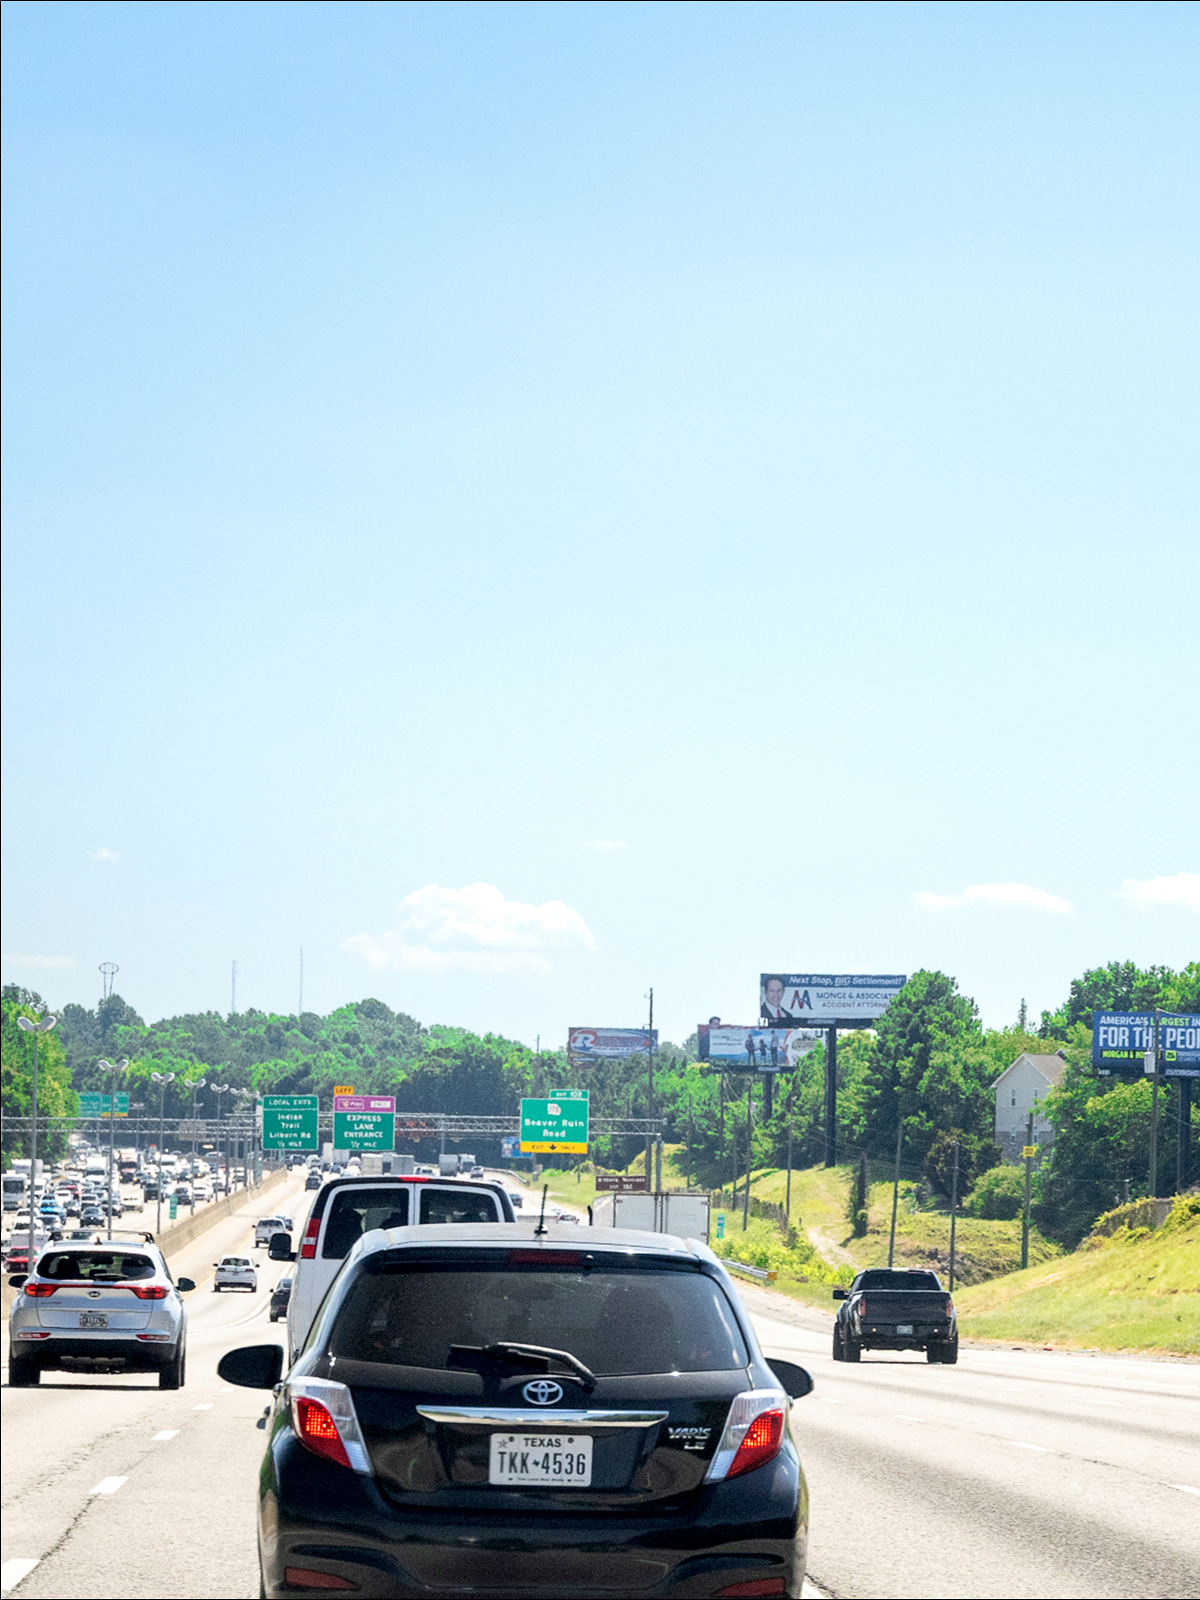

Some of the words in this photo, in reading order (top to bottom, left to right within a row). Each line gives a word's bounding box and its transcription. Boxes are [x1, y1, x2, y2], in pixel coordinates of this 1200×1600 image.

[789, 976, 809, 984] Next
[811, 976, 833, 986] Stop,
[834, 977, 851, 985] BIG
[852, 977, 902, 985] Settlement!
[1099, 1015, 1149, 1026] AMERICA'S
[1099, 1026, 1129, 1047] FOR
[346, 1114, 382, 1122] EXPRESS
[524, 1118, 557, 1126] Beaver
[561, 1119, 584, 1127] Ruin
[281, 1121, 300, 1129] Trail
[542, 1129, 566, 1137] Road
[668, 1426, 712, 1439] YARIS
[523, 1437, 562, 1448] TEXAS
[498, 1451, 530, 1474] TKK
[541, 1452, 586, 1476] 4536
